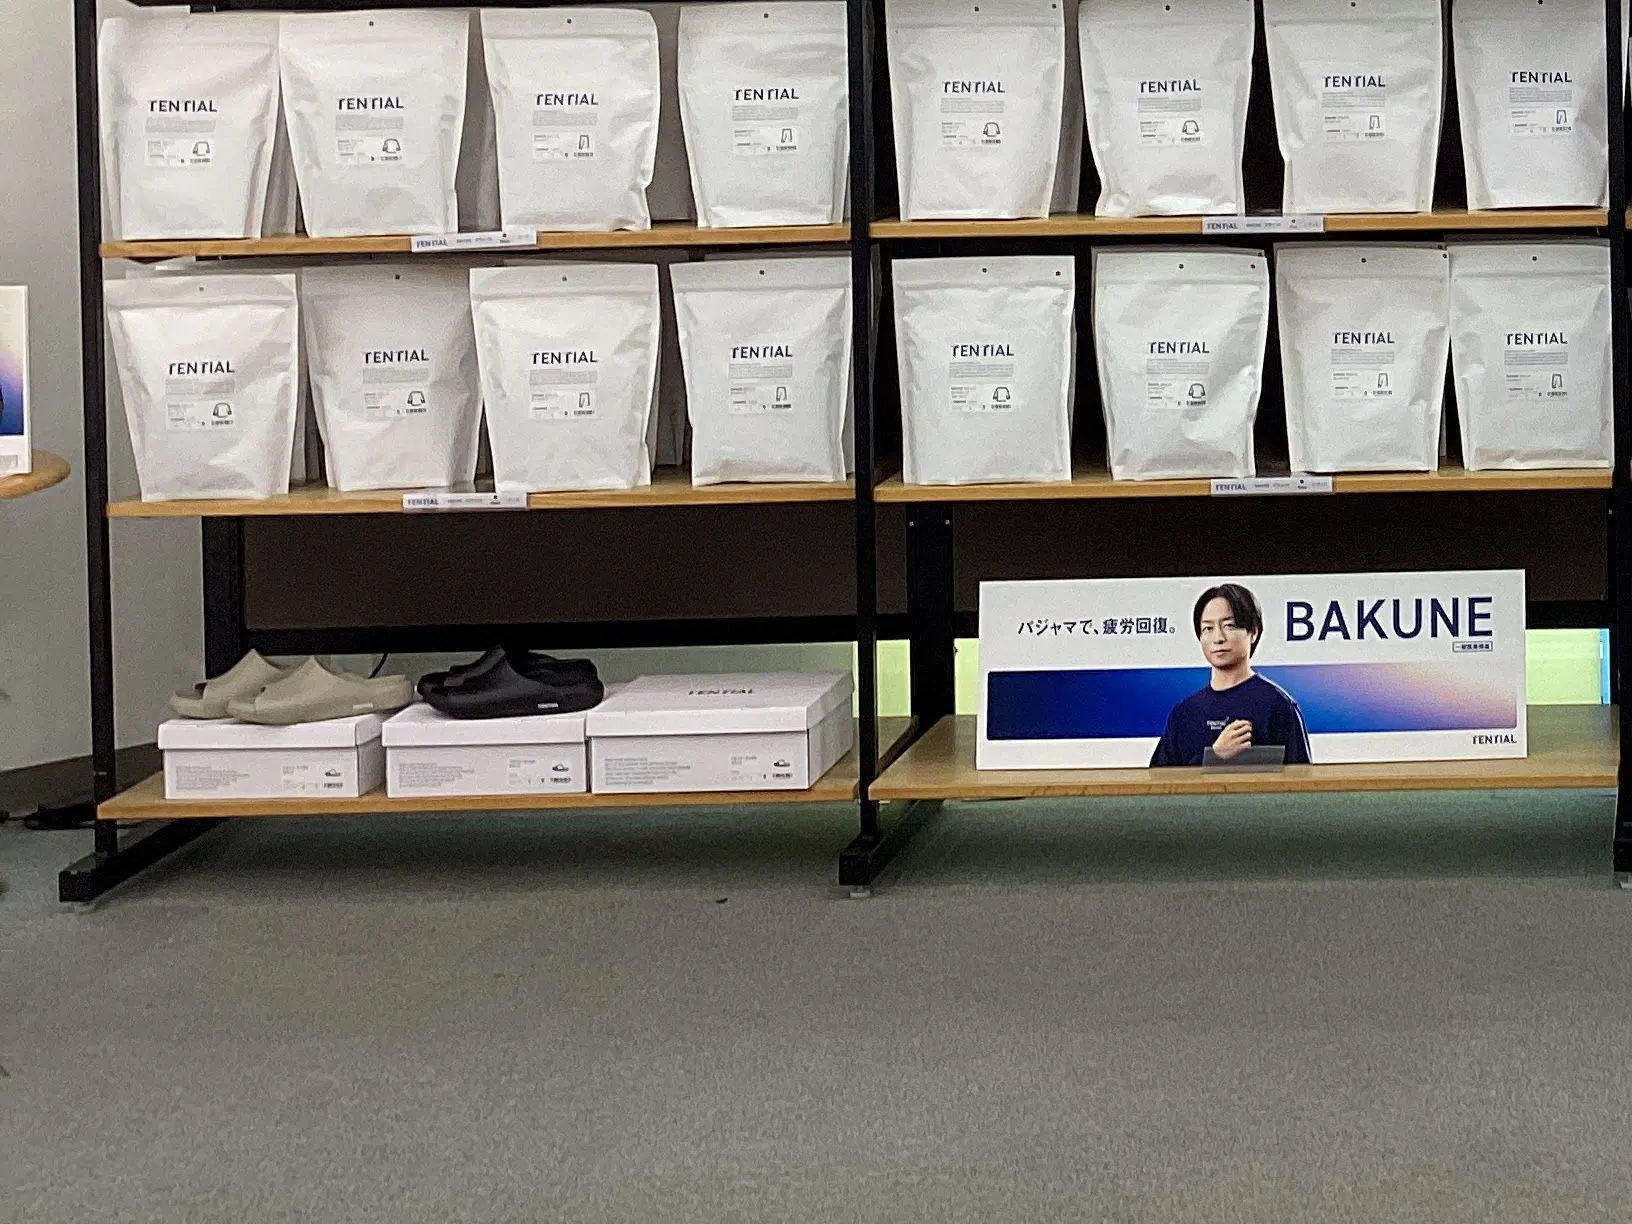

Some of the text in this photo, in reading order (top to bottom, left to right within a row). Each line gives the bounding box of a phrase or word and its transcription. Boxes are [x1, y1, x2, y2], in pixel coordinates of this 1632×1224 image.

[1323, 75, 1386, 88] TENTIAL
[1510, 71, 1573, 84] TENTIAL
[943, 80, 1006, 94] TENTIAL
[1139, 78, 1202, 93] TENTIAL
[535, 93, 599, 106] TENTIAL
[734, 87, 799, 101] TENTIAL
[149, 99, 218, 113] TENTIAL
[337, 96, 405, 110] TENTIAL
[1333, 331, 1395, 345] TENTIAL
[1505, 332, 1568, 346] TENTIAL
[731, 345, 793, 359] TENTIAL
[951, 343, 1015, 358] TENTIAL
[1149, 341, 1210, 354] TENTIAL
[364, 349, 430, 364] TENTIAL
[532, 350, 598, 365] TENTIAL
[168, 360, 236, 375] TENTIAL
[1285, 596, 1493, 642] BAKUNE
[1017, 617, 1177, 637] パジャマで、疲労回復。
[1471, 734, 1517, 744] TENTIAL
